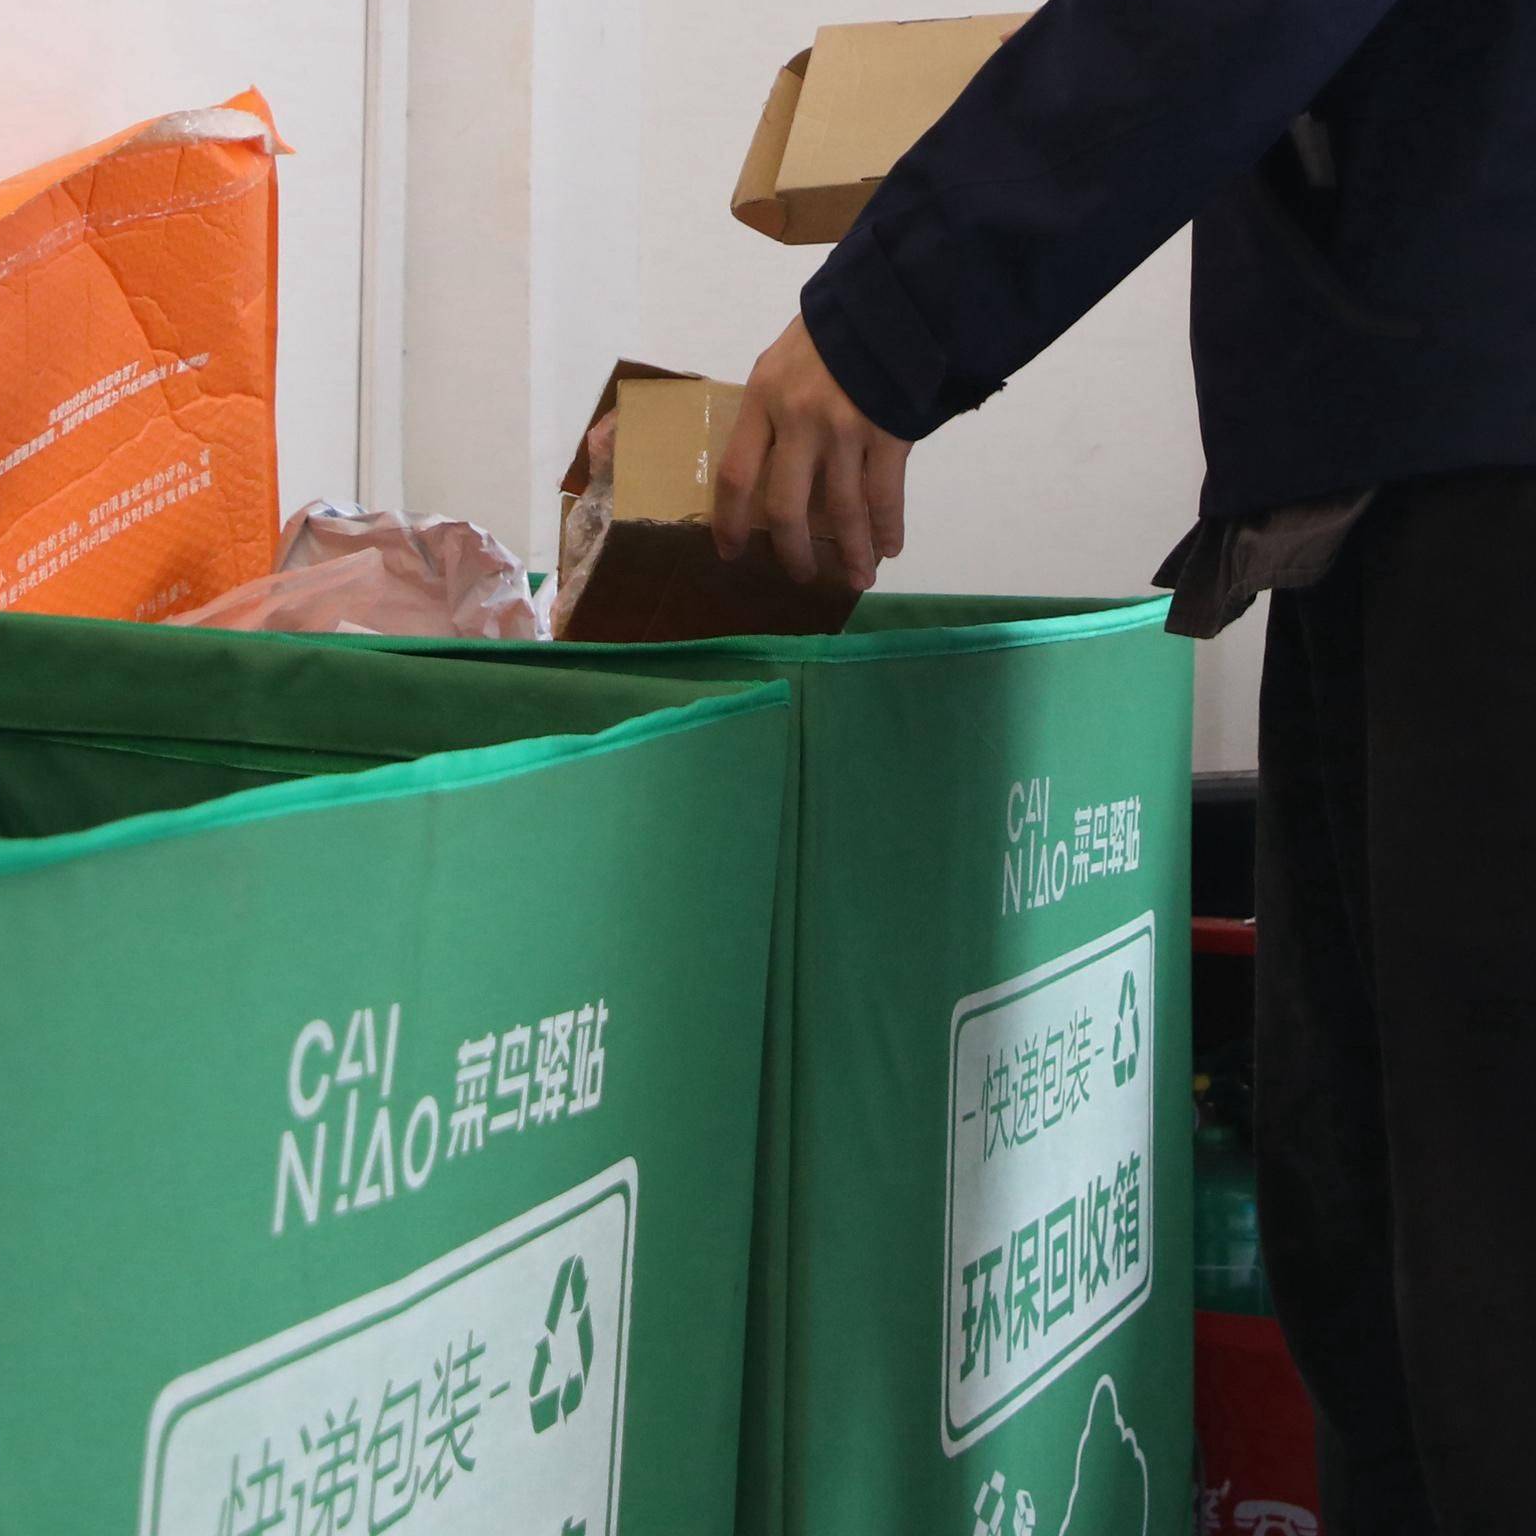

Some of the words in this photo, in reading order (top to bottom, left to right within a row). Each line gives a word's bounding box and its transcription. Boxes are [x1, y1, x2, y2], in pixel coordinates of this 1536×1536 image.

[1006, 776, 1051, 843] CAI
[1071, 795, 1142, 886] 菜鸟驿站
[287, 1002, 401, 1118] CAI
[446, 998, 610, 1160] 菜鸟驿站
[959, 1150, 1142, 1384] 环保回收箱
